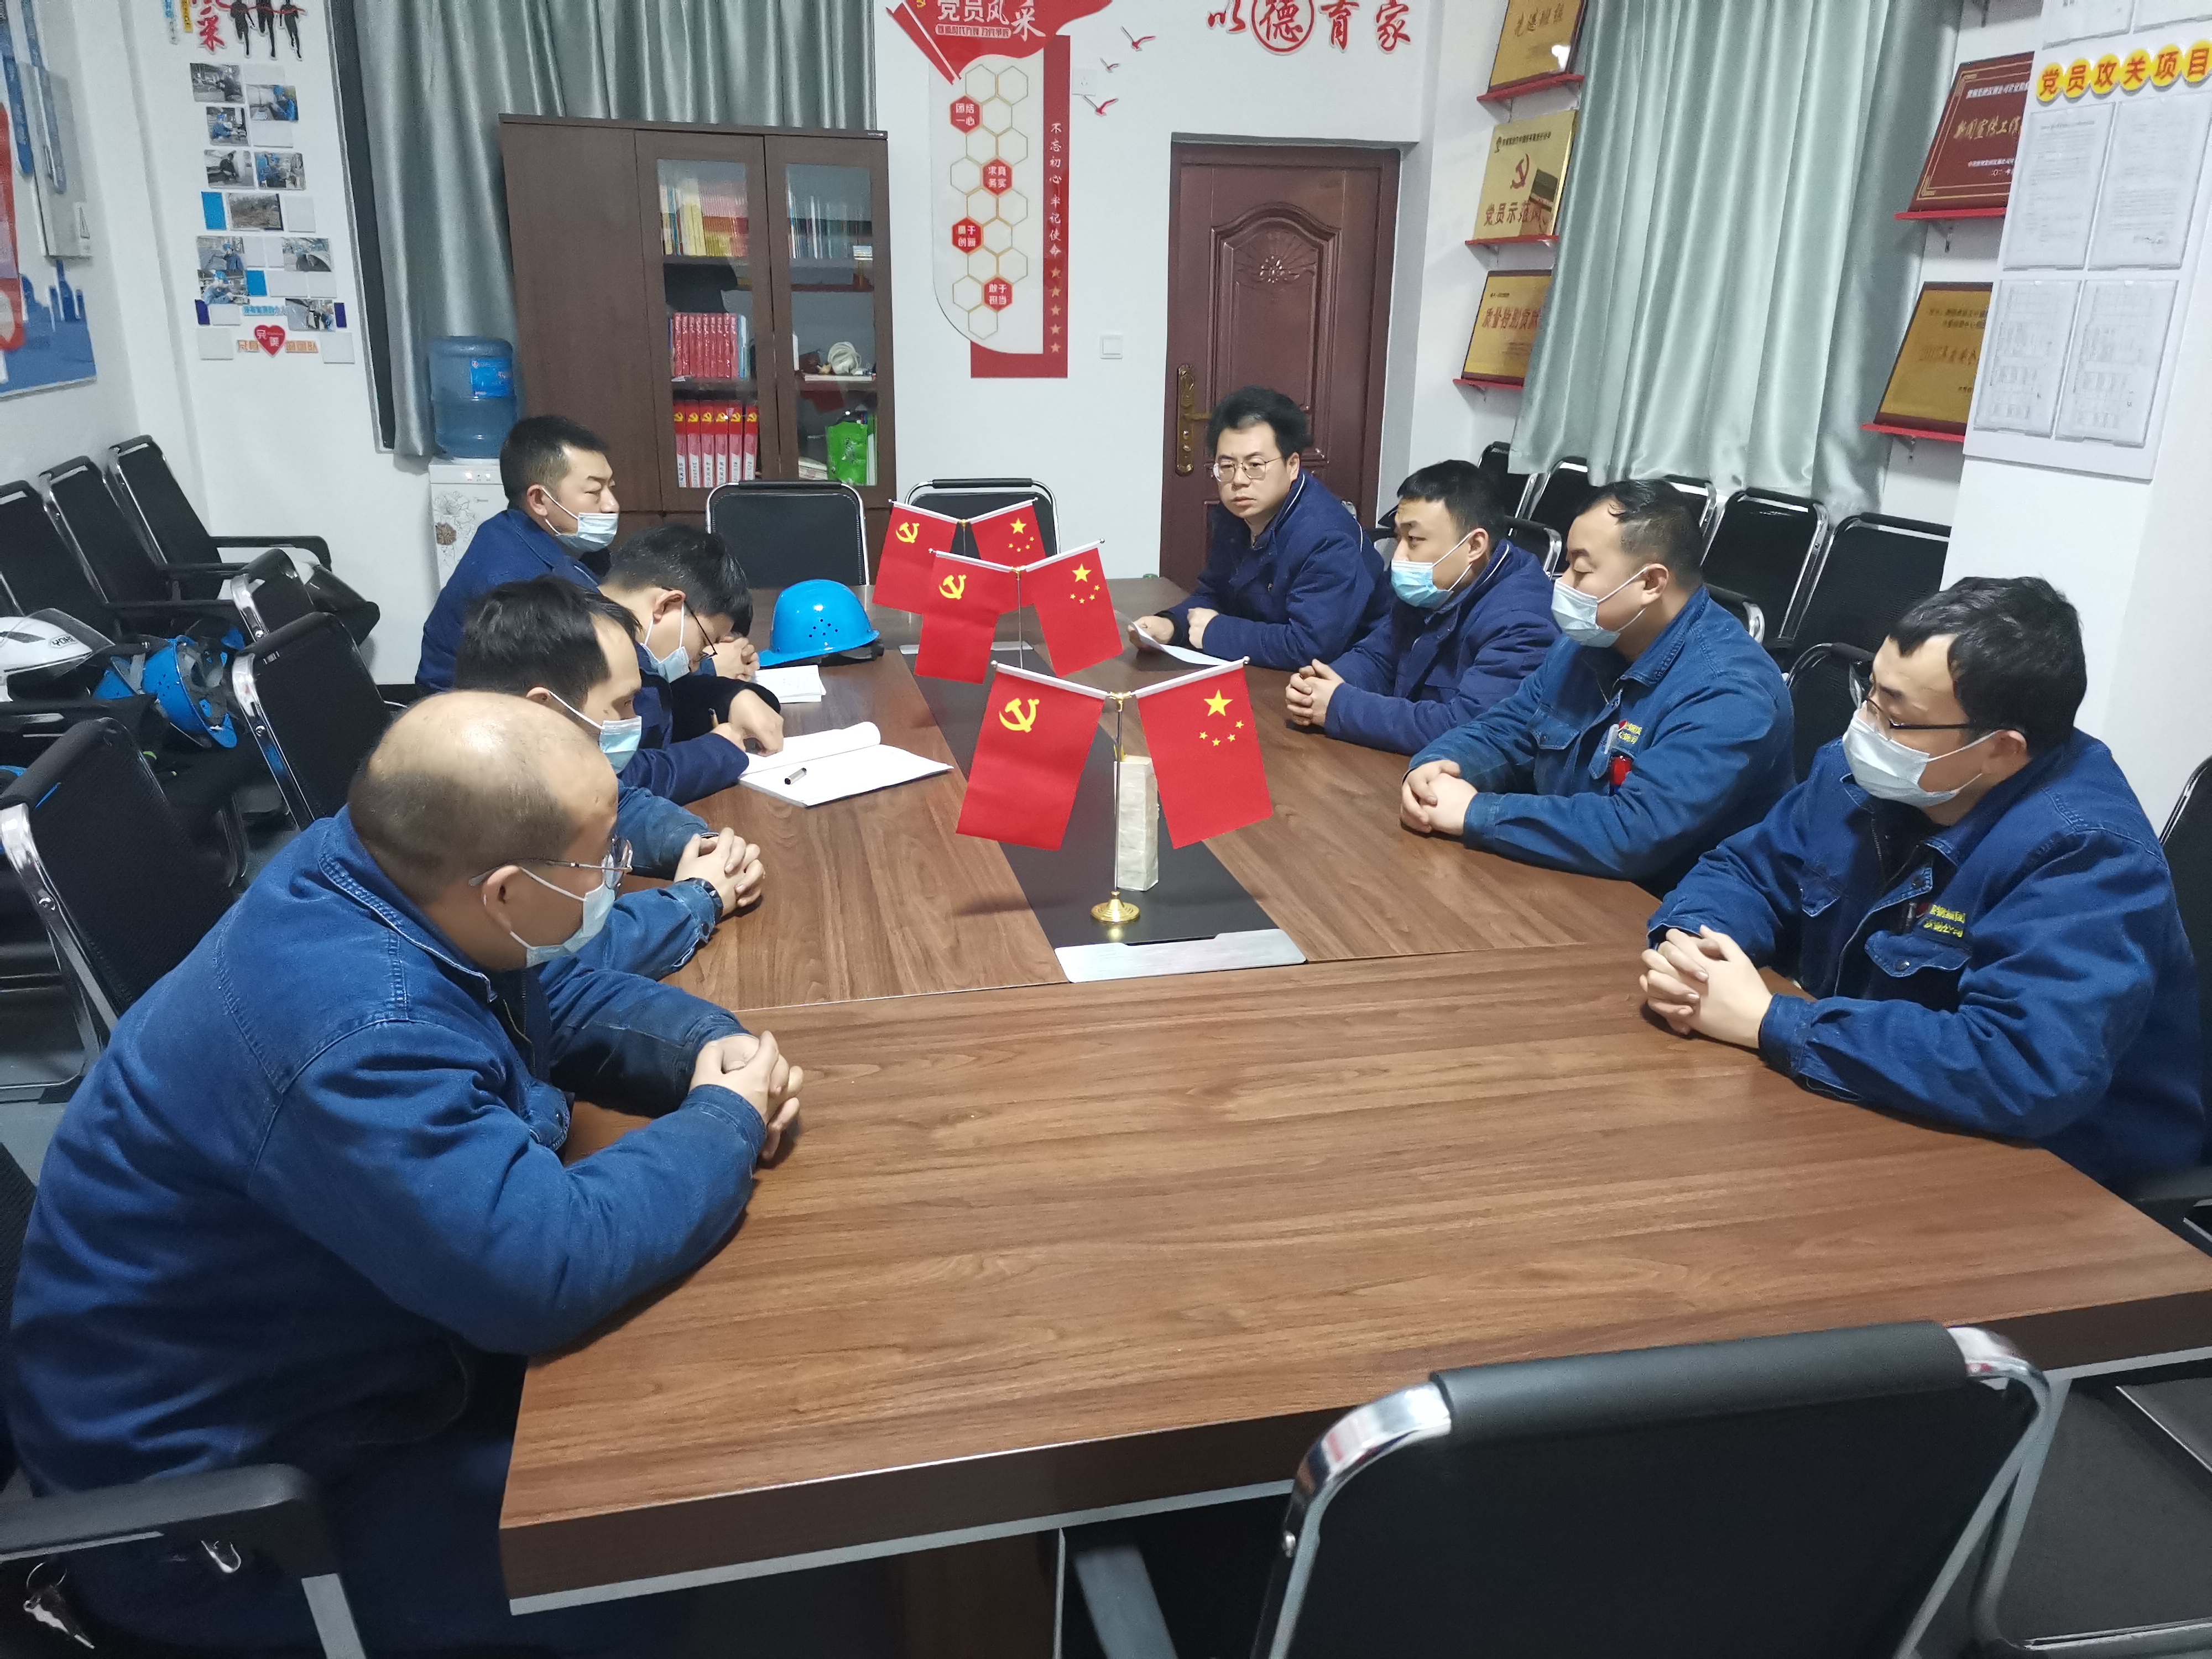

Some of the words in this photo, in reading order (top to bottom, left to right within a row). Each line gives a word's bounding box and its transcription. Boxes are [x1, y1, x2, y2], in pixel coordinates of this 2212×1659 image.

[2040, 47, 2210, 96] 党员攻关项目
